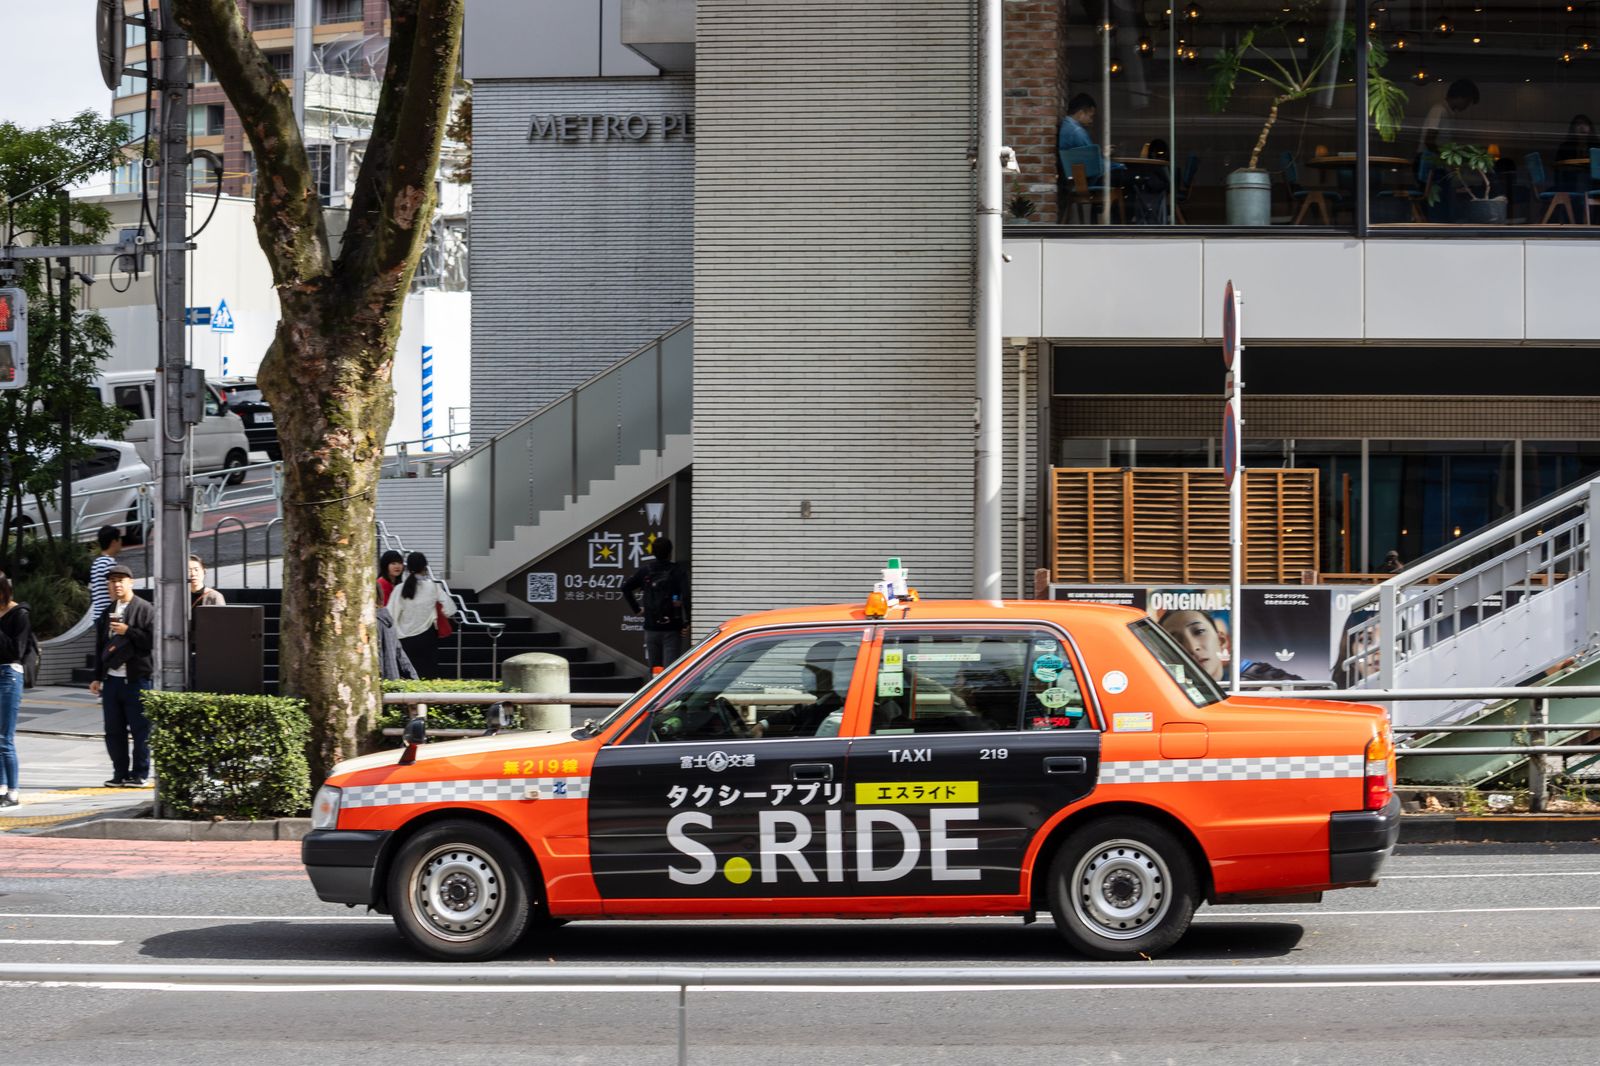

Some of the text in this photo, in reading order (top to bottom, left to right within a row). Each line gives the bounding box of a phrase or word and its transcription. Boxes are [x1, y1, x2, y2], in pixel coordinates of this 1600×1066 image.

[527, 112, 649, 142] METRO
[888, 748, 932, 763] TAXI
[979, 748, 1009, 760] 219
[666, 782, 843, 808] タクシーアプリ
[877, 786, 957, 800] エスライド
[666, 807, 982, 885] S.RIDE
